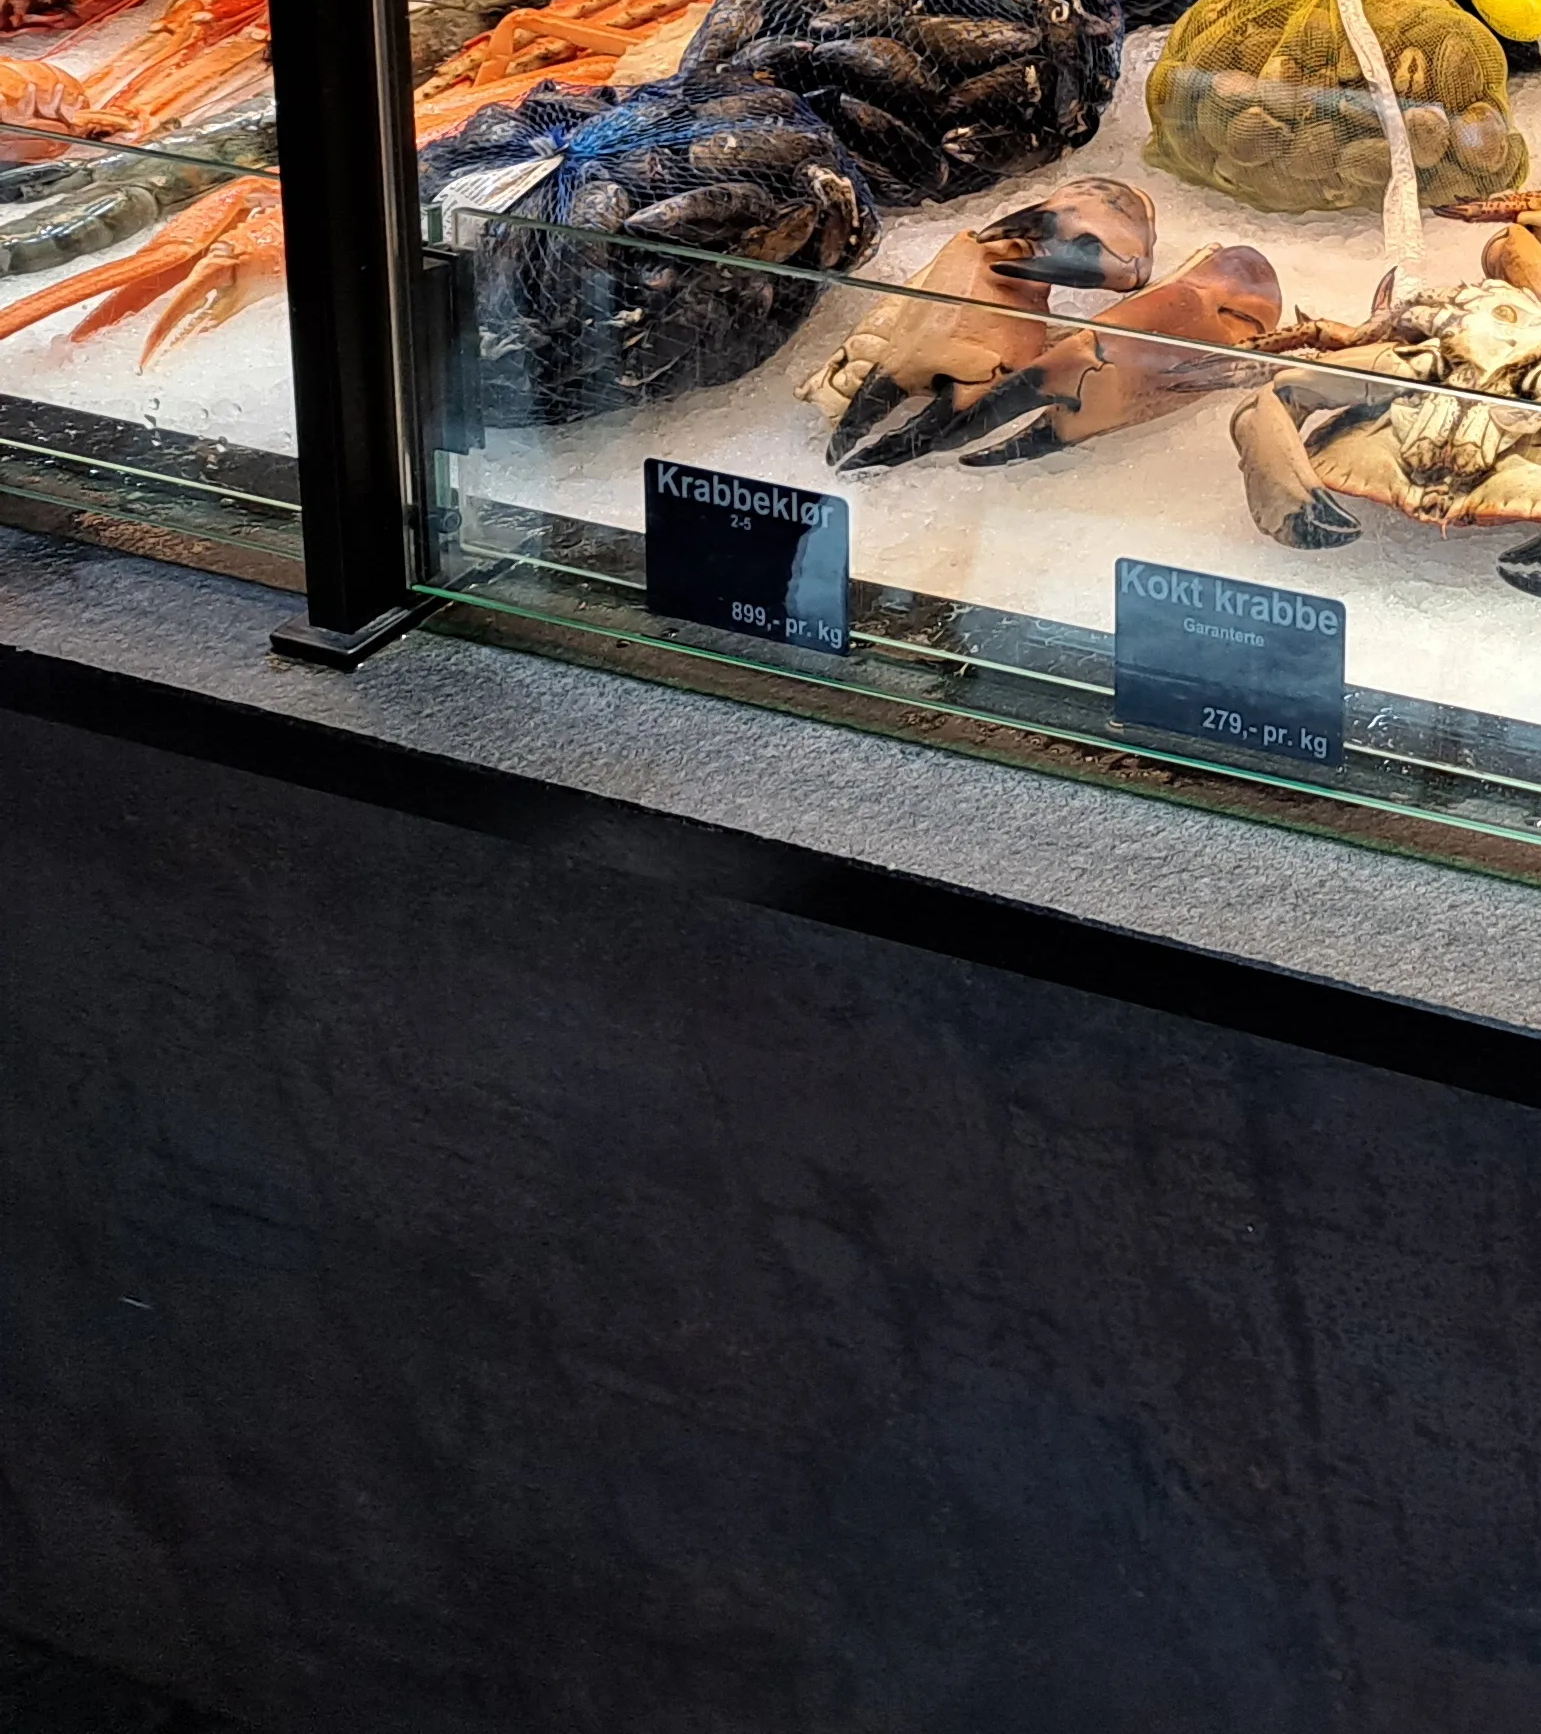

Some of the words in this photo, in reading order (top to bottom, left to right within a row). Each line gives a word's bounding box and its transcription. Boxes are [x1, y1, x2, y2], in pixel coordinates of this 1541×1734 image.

[657, 463, 834, 529] Krabbeklør
[730, 513, 752, 531] 2-5
[731, 601, 781, 632] 899,-
[785, 617, 812, 638] pr.
[818, 619, 842, 649] kg
[1121, 562, 1203, 609] Kokt
[1214, 580, 1339, 636] krabbe
[1202, 707, 1258, 740] 279,-
[1263, 725, 1293, 747] pr.
[1300, 727, 1328, 759] kg
